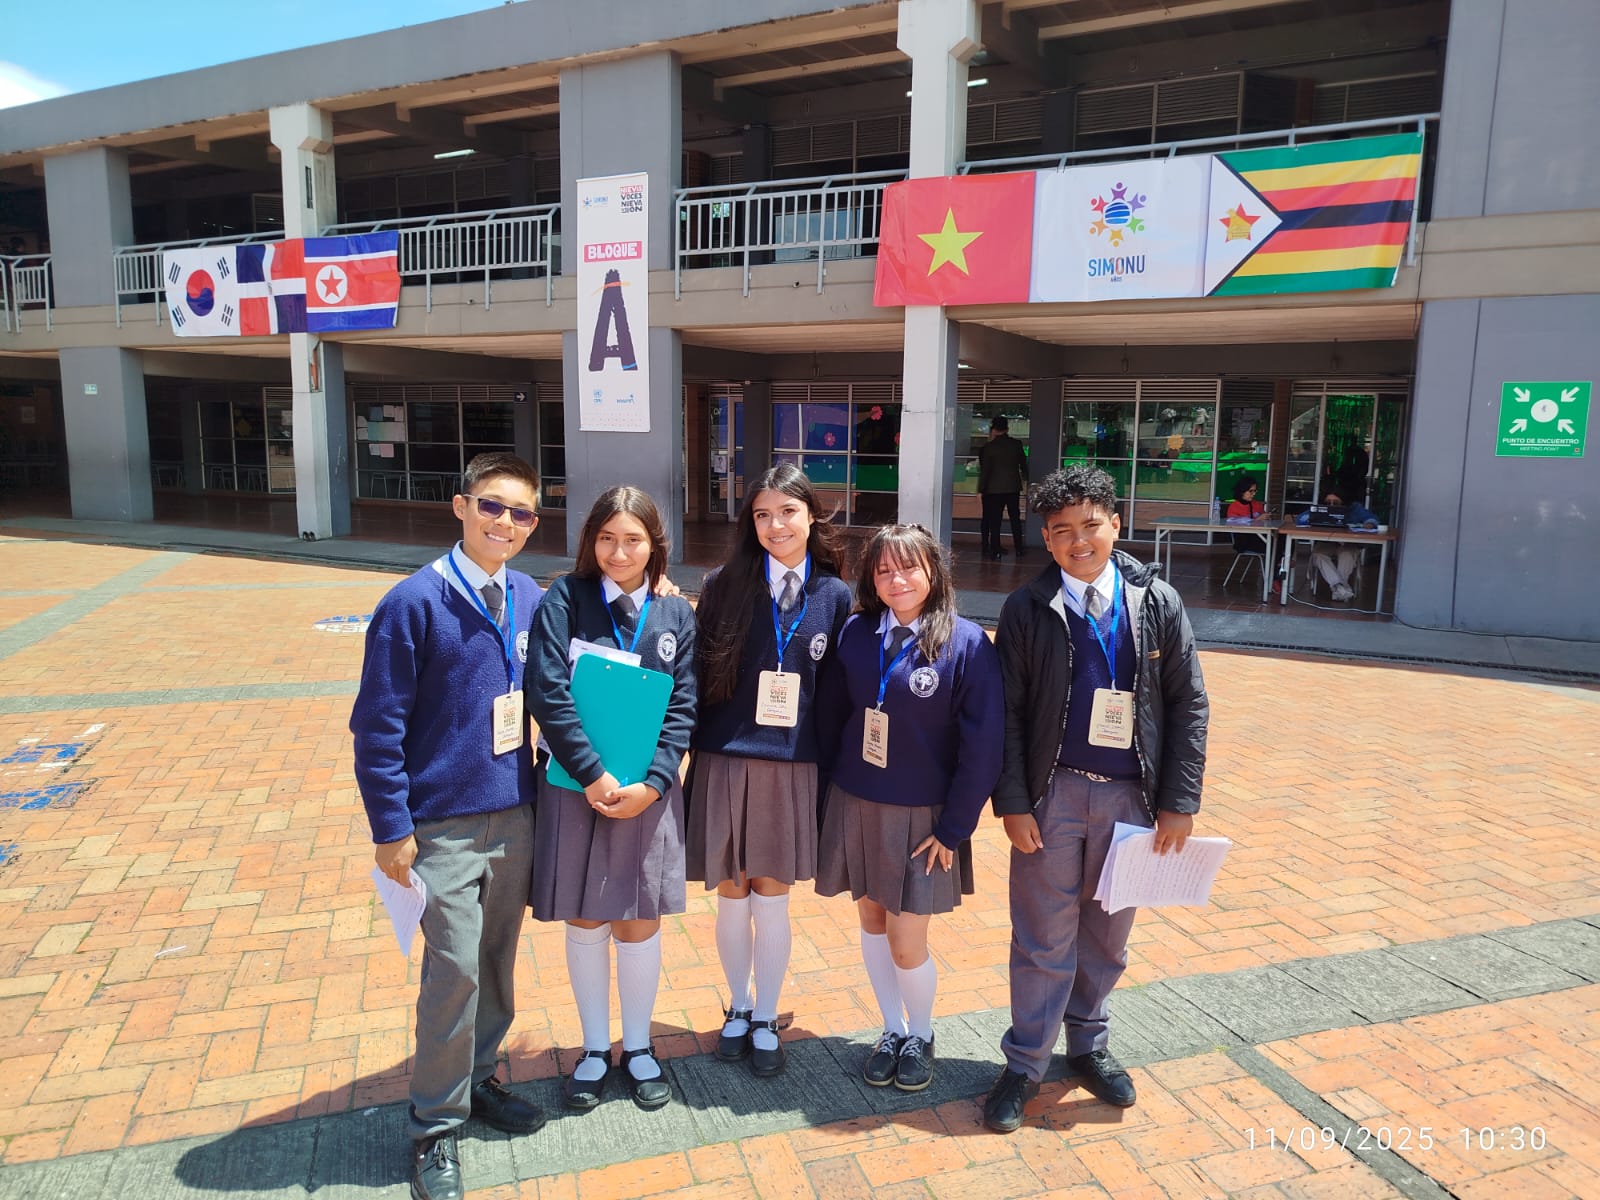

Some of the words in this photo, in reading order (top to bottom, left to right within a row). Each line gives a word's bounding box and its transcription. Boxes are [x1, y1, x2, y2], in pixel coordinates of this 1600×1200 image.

[588, 243, 638, 260] BLOQUE
[1088, 254, 1145, 276] SIMONU
[588, 268, 638, 372] A
